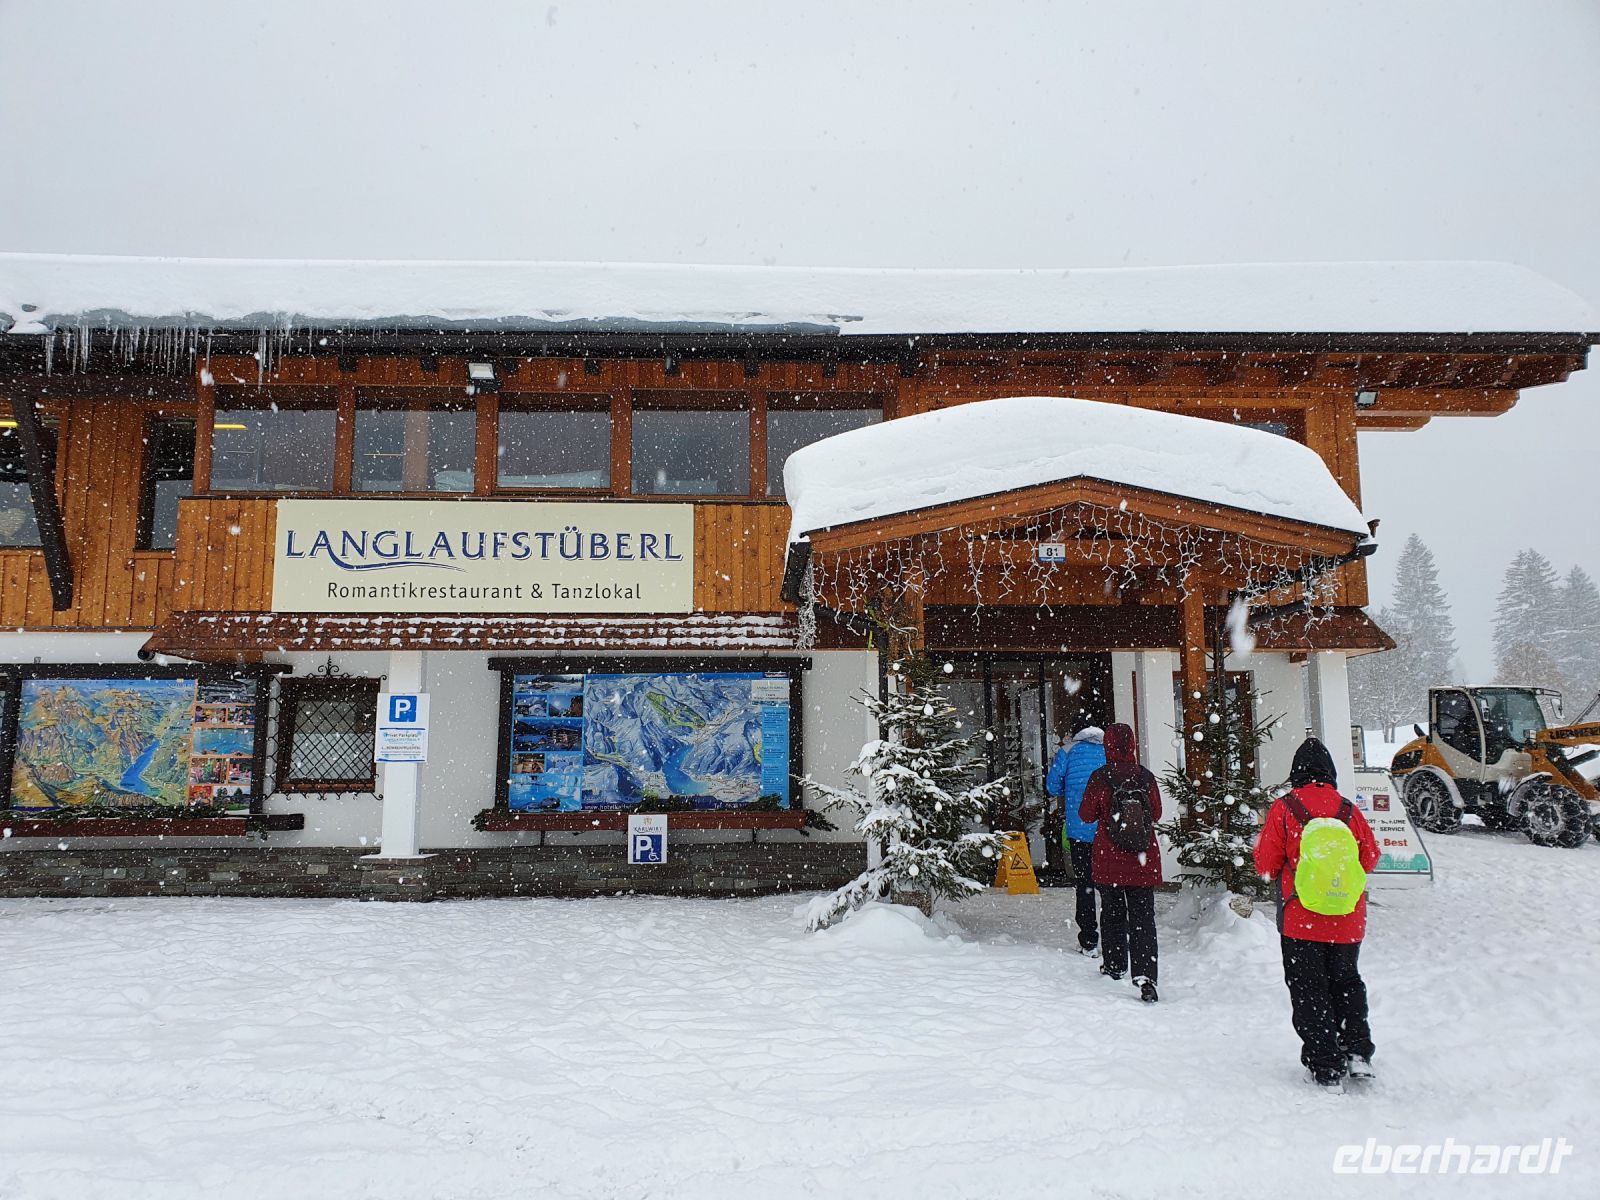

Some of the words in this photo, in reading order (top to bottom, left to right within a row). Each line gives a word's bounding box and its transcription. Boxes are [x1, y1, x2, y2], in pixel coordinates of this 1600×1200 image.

[286, 525, 683, 571] LANGLAUFSTÜBERL
[1046, 547, 1058, 557] 81
[327, 581, 523, 600] Romantikrestaurant
[530, 583, 544, 600] &
[552, 583, 642, 600] Tanzlokal
[395, 699, 411, 718] P
[635, 835, 652, 860] P
[1383, 838, 1409, 847] Best
